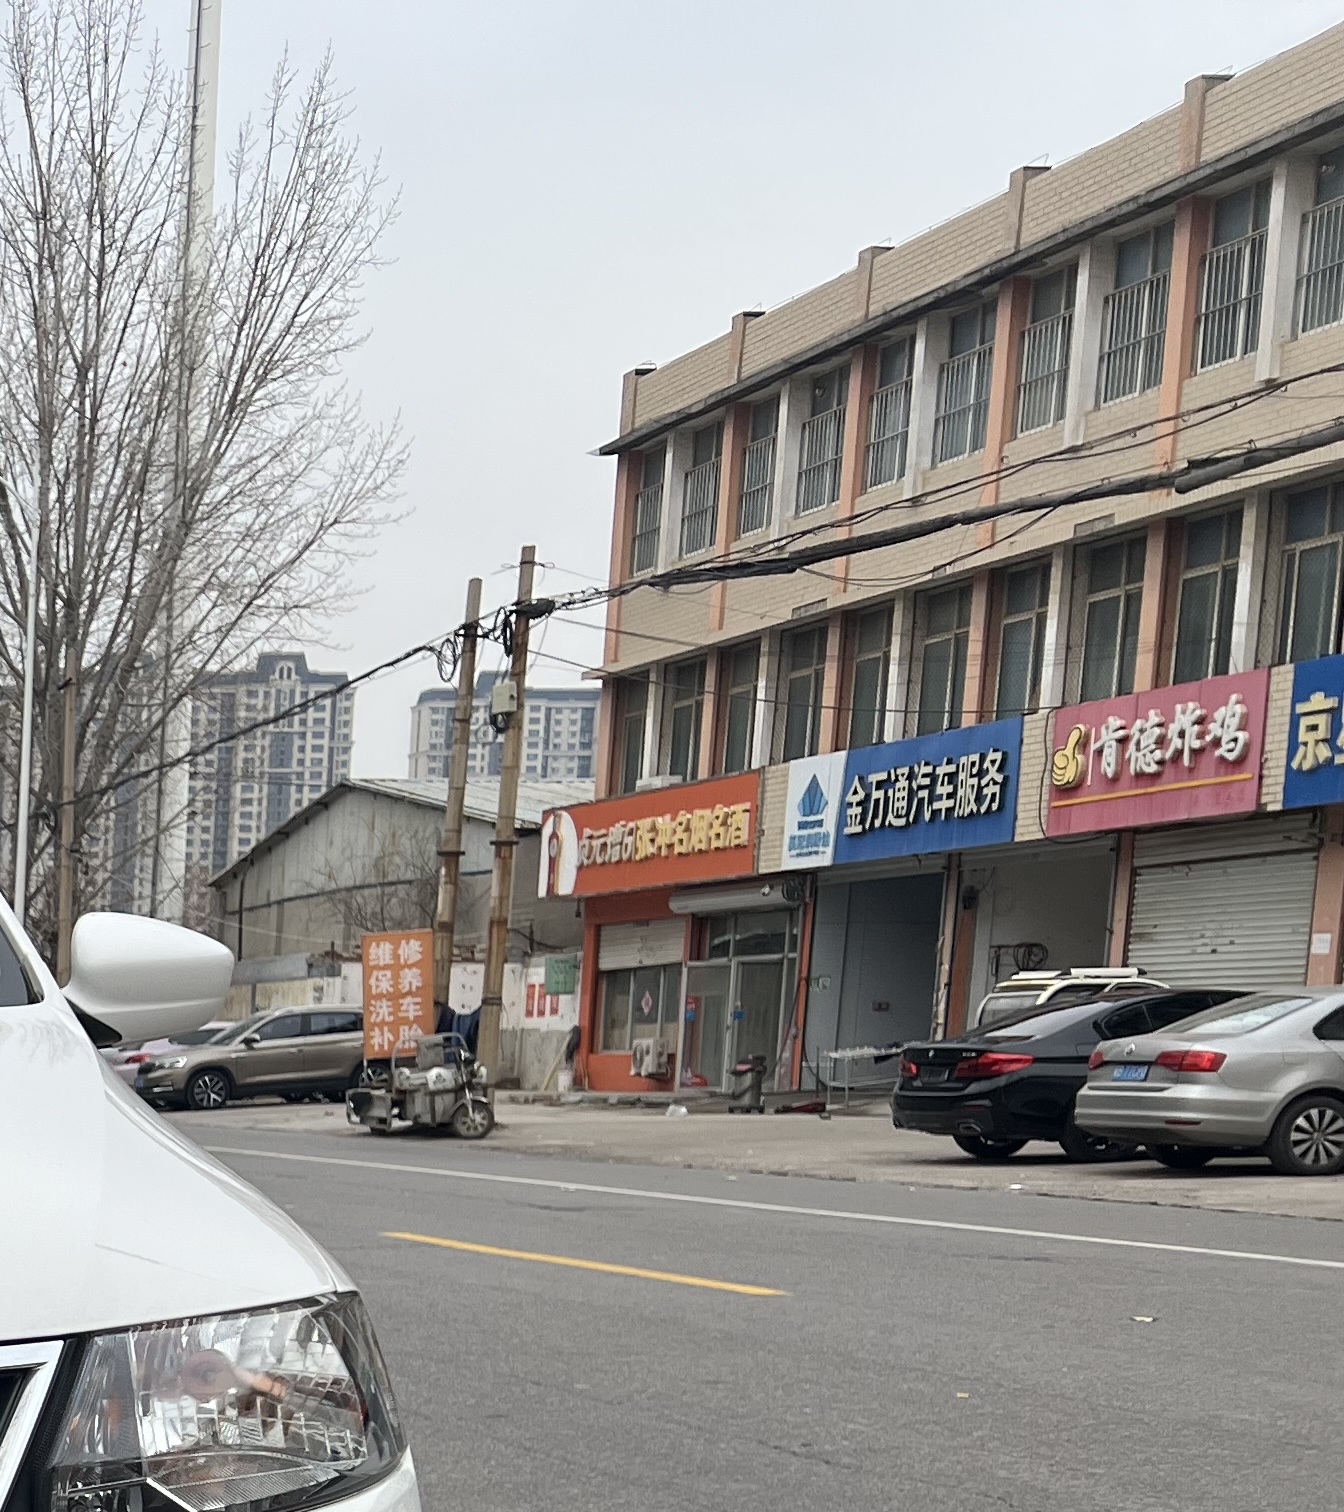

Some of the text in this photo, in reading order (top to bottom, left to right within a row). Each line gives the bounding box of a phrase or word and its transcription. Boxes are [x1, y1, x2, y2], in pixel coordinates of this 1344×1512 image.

[1093, 693, 1250, 779] 肯德炸鸡
[843, 748, 1004, 835] 金万通汽车服务
[635, 802, 751, 861] 张冲名烟名酒
[369, 939, 424, 966] 维修
[369, 967, 423, 995] 保养
[369, 996, 423, 1023] 洗车
[370, 1025, 425, 1051] 补胎
